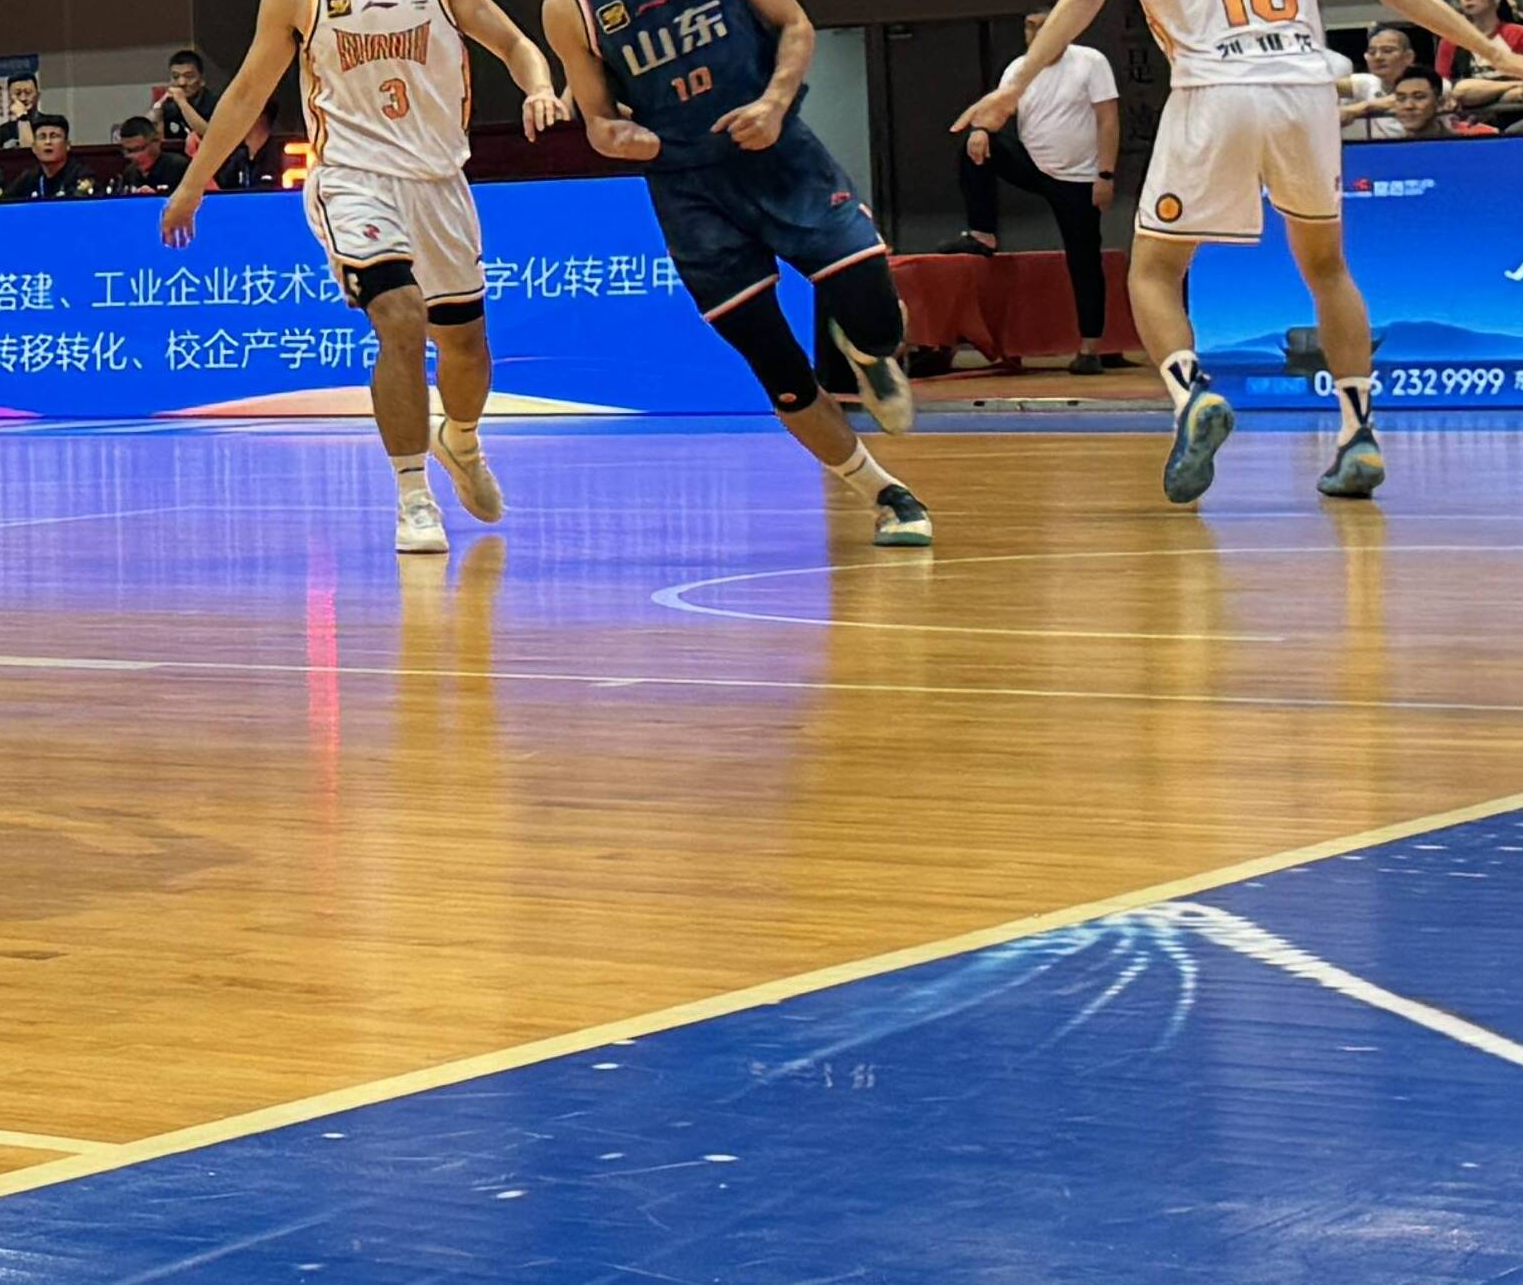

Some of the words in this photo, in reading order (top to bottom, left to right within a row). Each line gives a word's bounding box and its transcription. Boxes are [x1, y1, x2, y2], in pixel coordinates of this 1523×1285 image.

[621, 0, 729, 77] 山东
[379, 77, 411, 120] 3
[670, 65, 714, 102] 10
